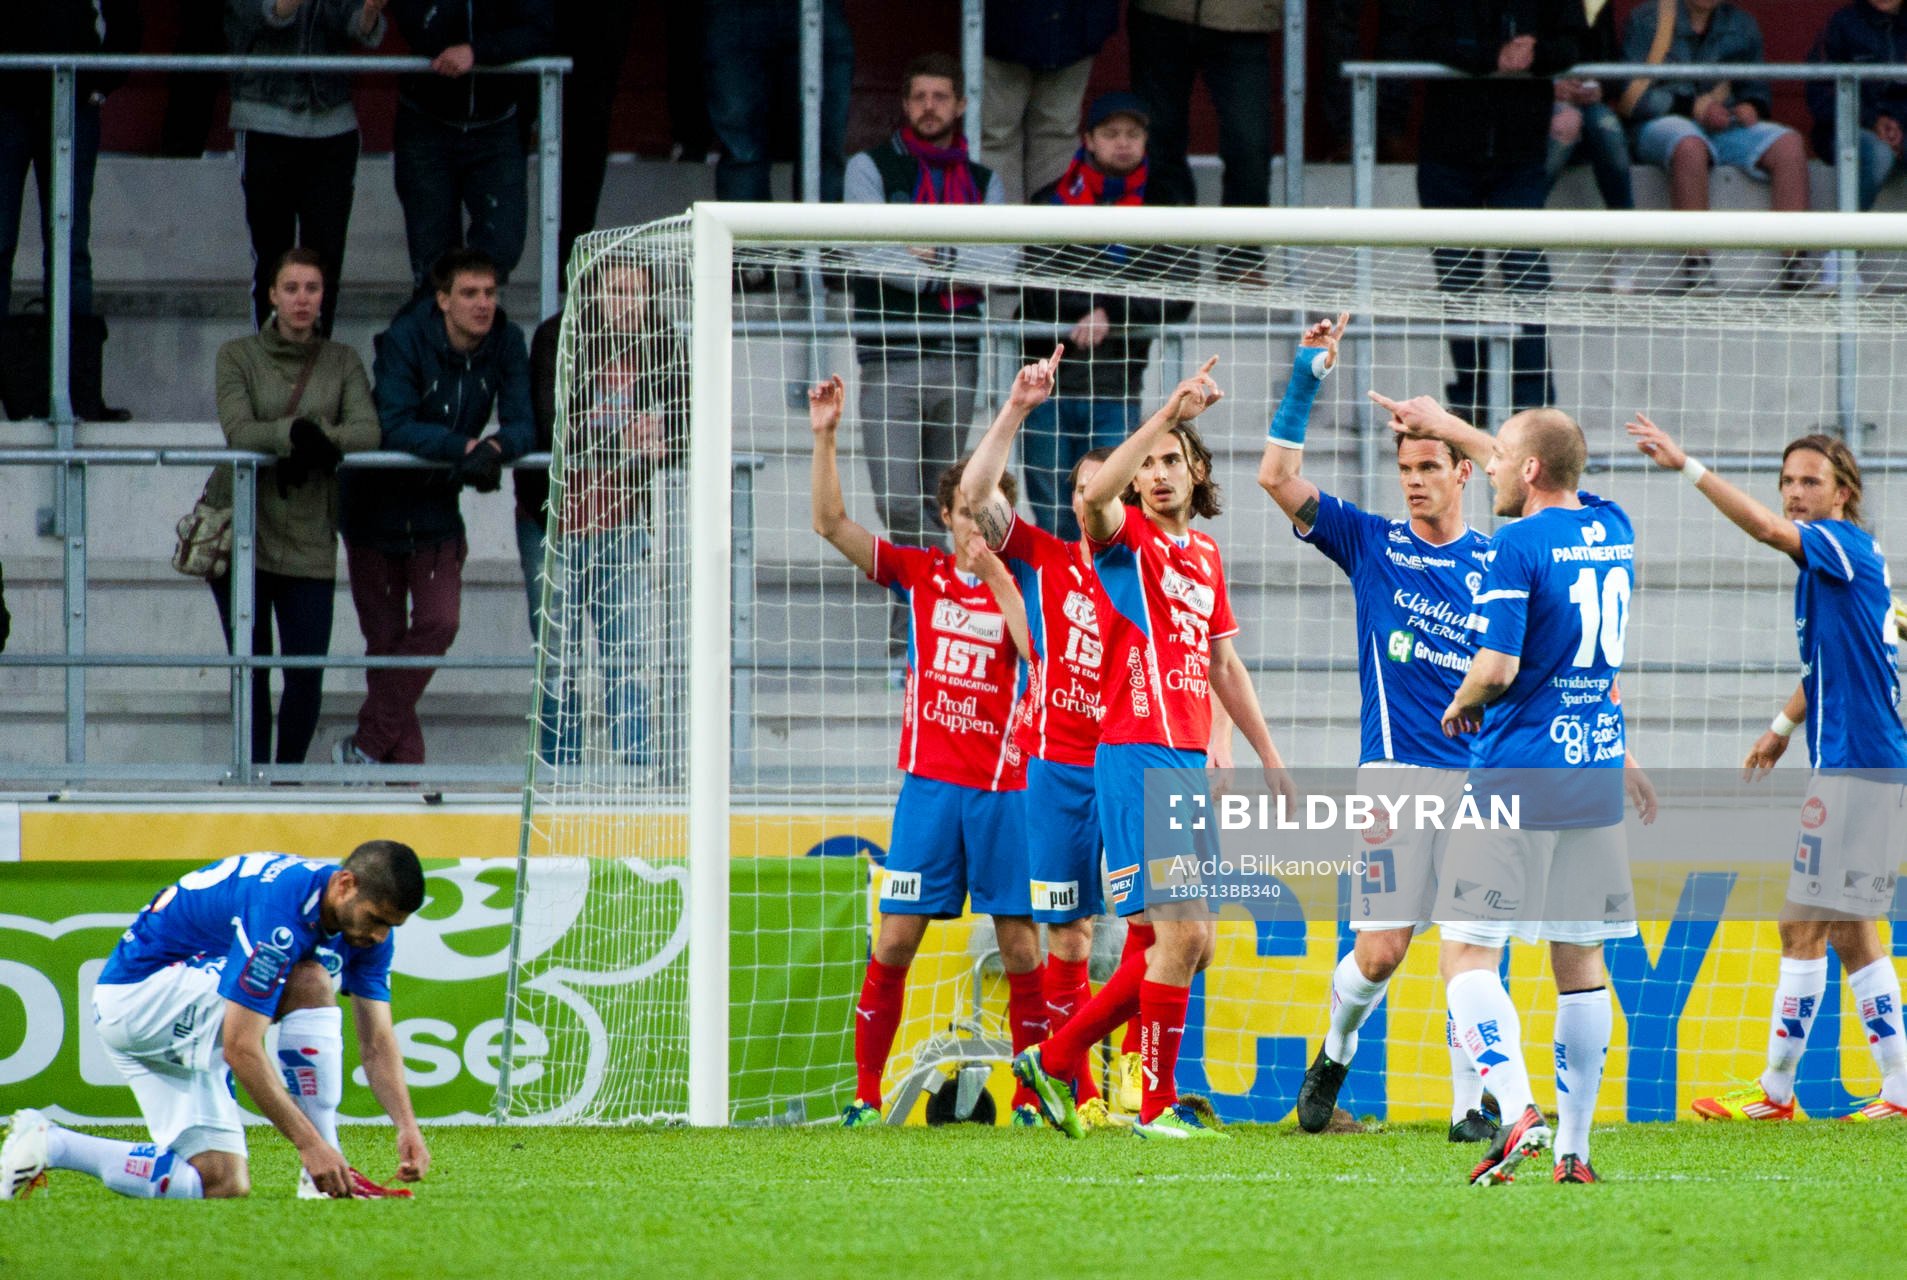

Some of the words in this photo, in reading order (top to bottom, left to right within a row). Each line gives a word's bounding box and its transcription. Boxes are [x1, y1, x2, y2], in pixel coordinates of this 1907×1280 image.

[1552, 543, 1634, 563] PARTNERTEC
[1393, 589, 1471, 628] Klädhu
[1569, 566, 1631, 668] 10
[932, 636, 996, 679] IST
[925, 670, 934, 679] IT
[948, 675, 999, 694] EDUCATION
[936, 689, 977, 718] Profil
[1361, 897, 1371, 917] 3
[1141, 1025, 1149, 1062] VIKING
